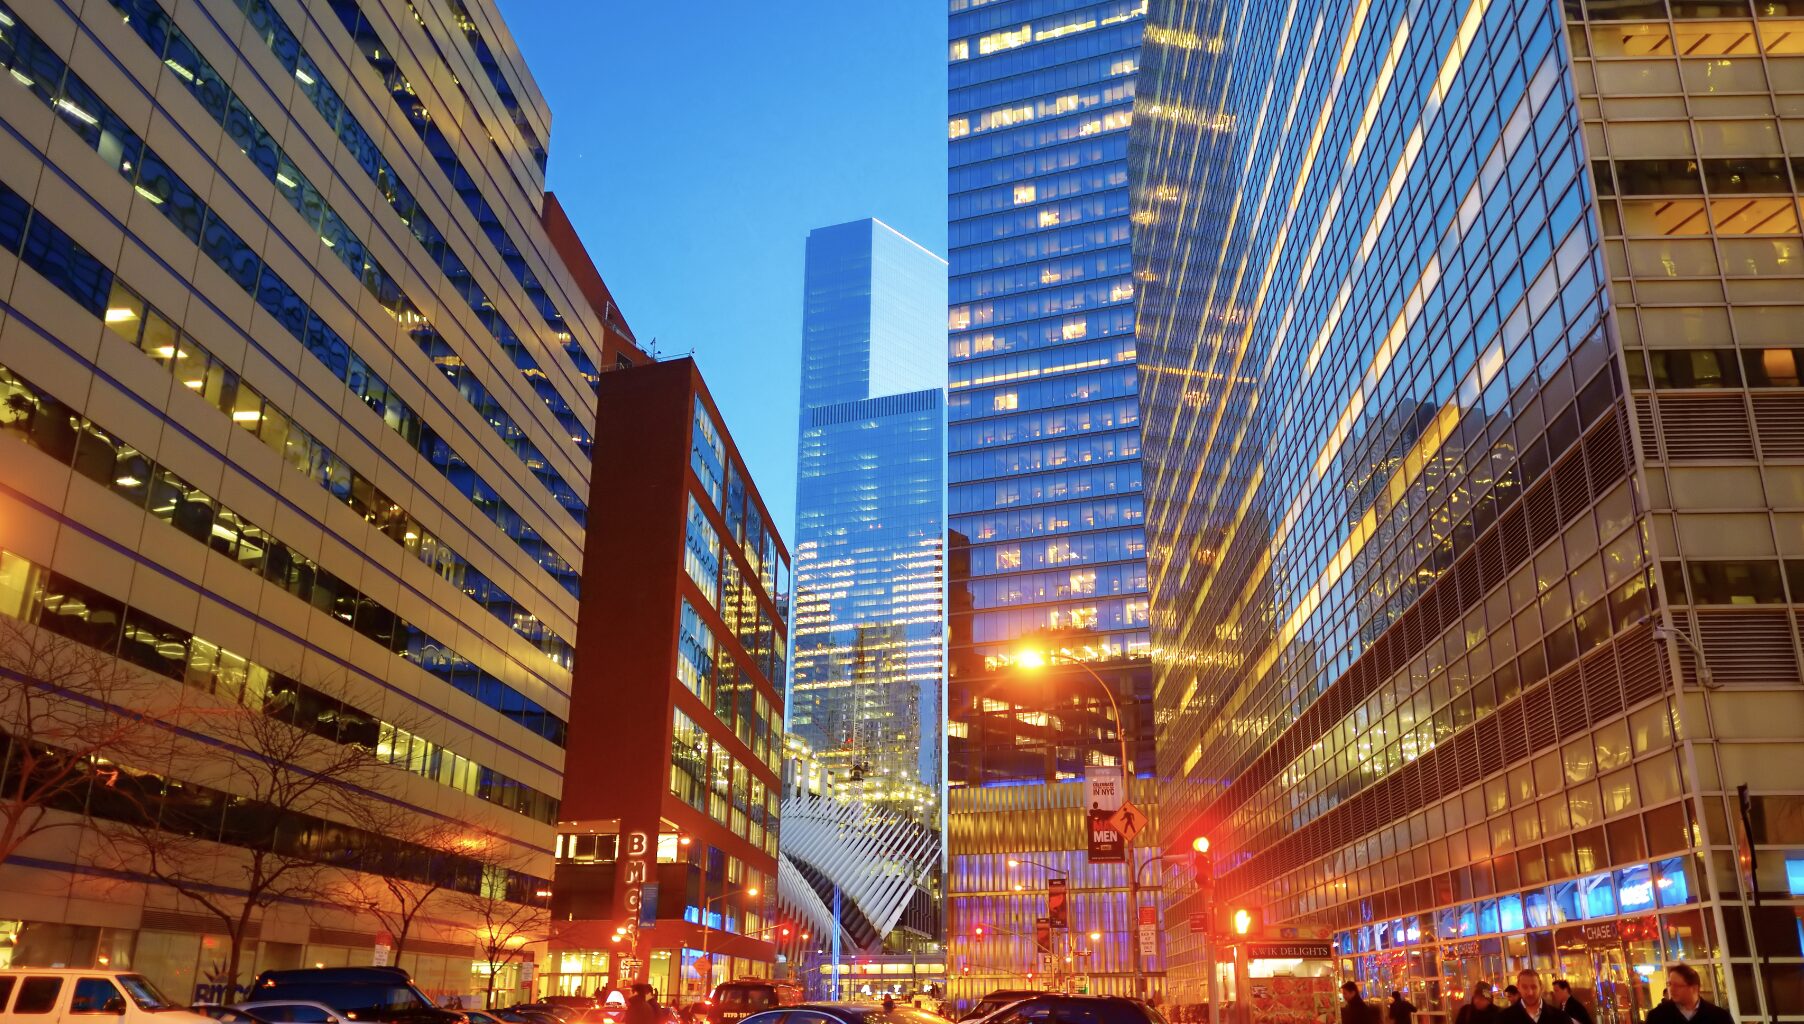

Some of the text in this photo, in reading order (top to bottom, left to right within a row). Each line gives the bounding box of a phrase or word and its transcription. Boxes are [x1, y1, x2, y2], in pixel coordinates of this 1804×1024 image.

[1093, 788, 1115, 796] IN NYC
[1093, 830, 1118, 843] MEN
[1586, 924, 1612, 940] CHASE
[1252, 947, 1328, 956] KWIK DELIGHTS
